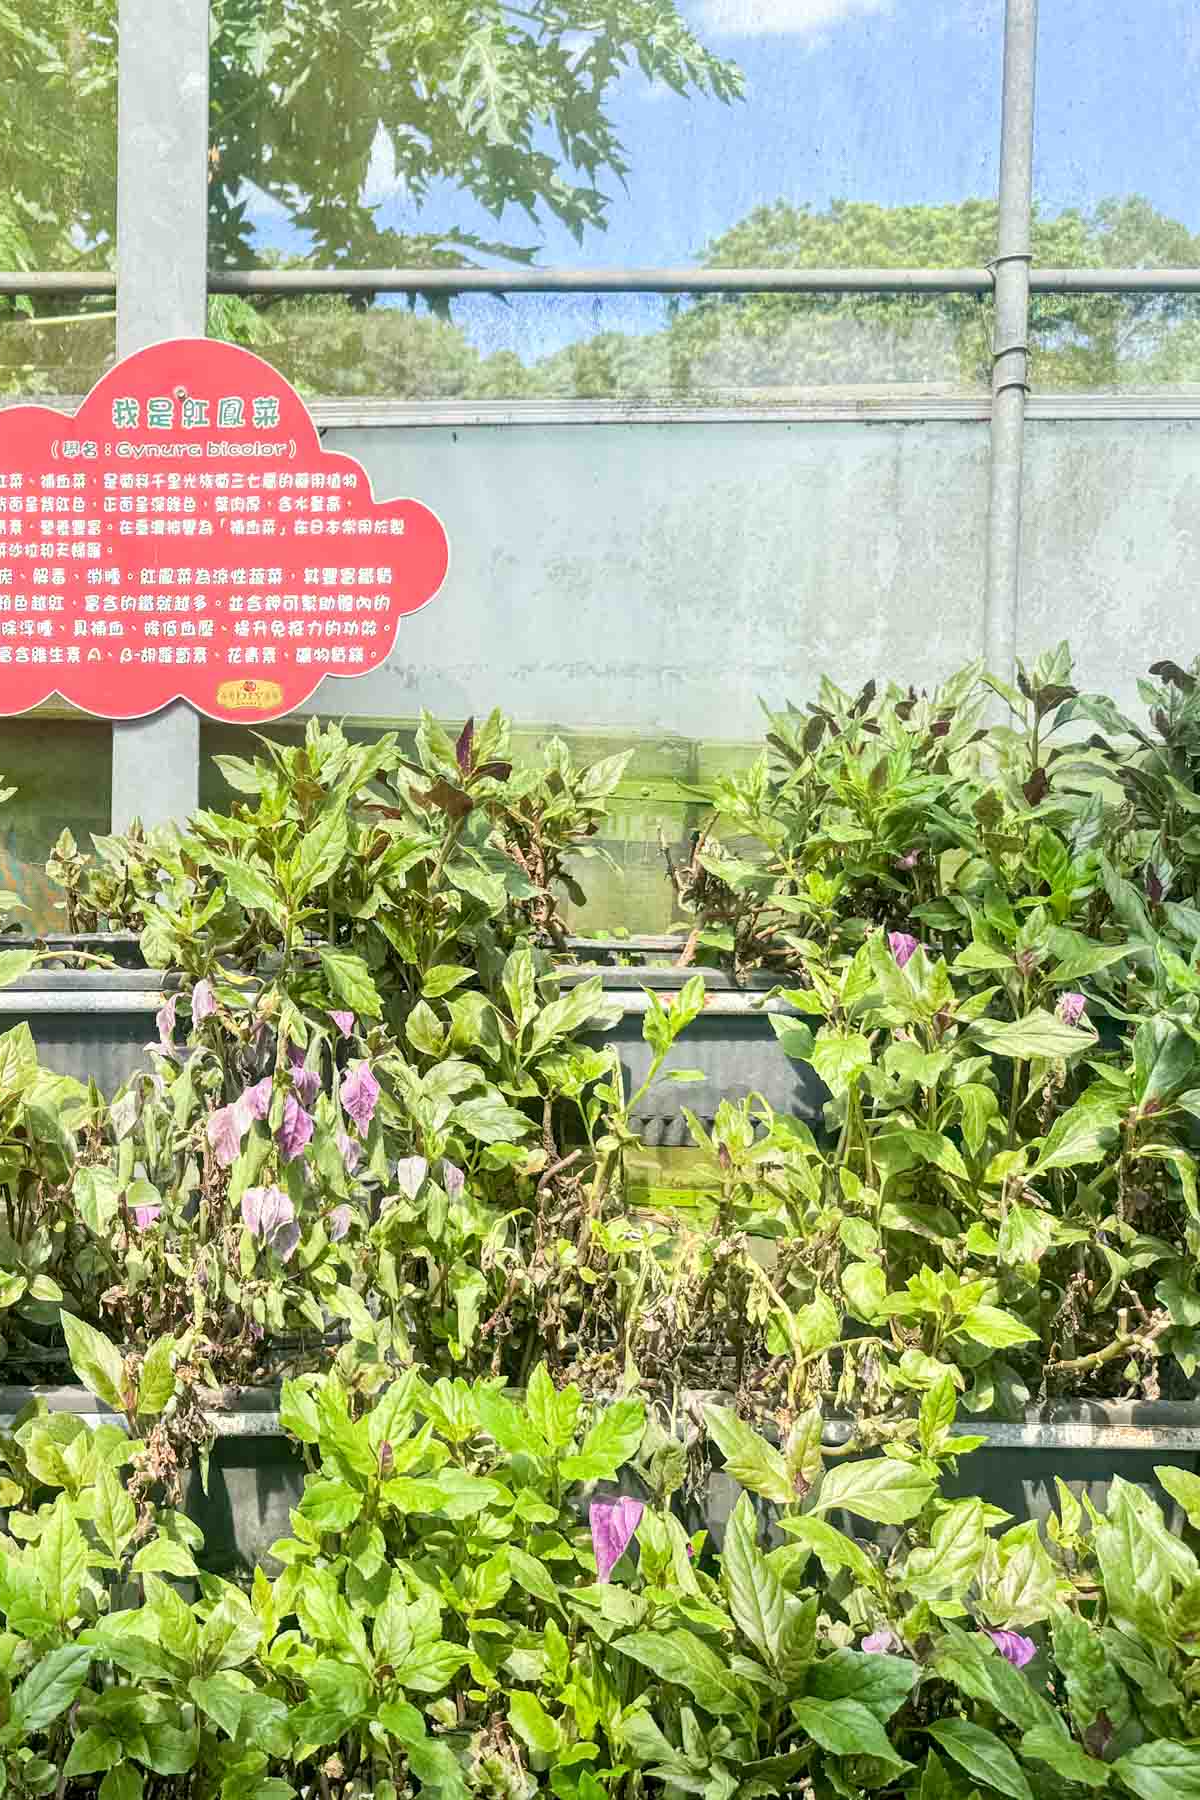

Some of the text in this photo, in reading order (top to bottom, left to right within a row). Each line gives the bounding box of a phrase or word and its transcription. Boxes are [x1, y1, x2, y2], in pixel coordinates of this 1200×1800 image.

[112, 397, 280, 429] 我是紅鳳菜
